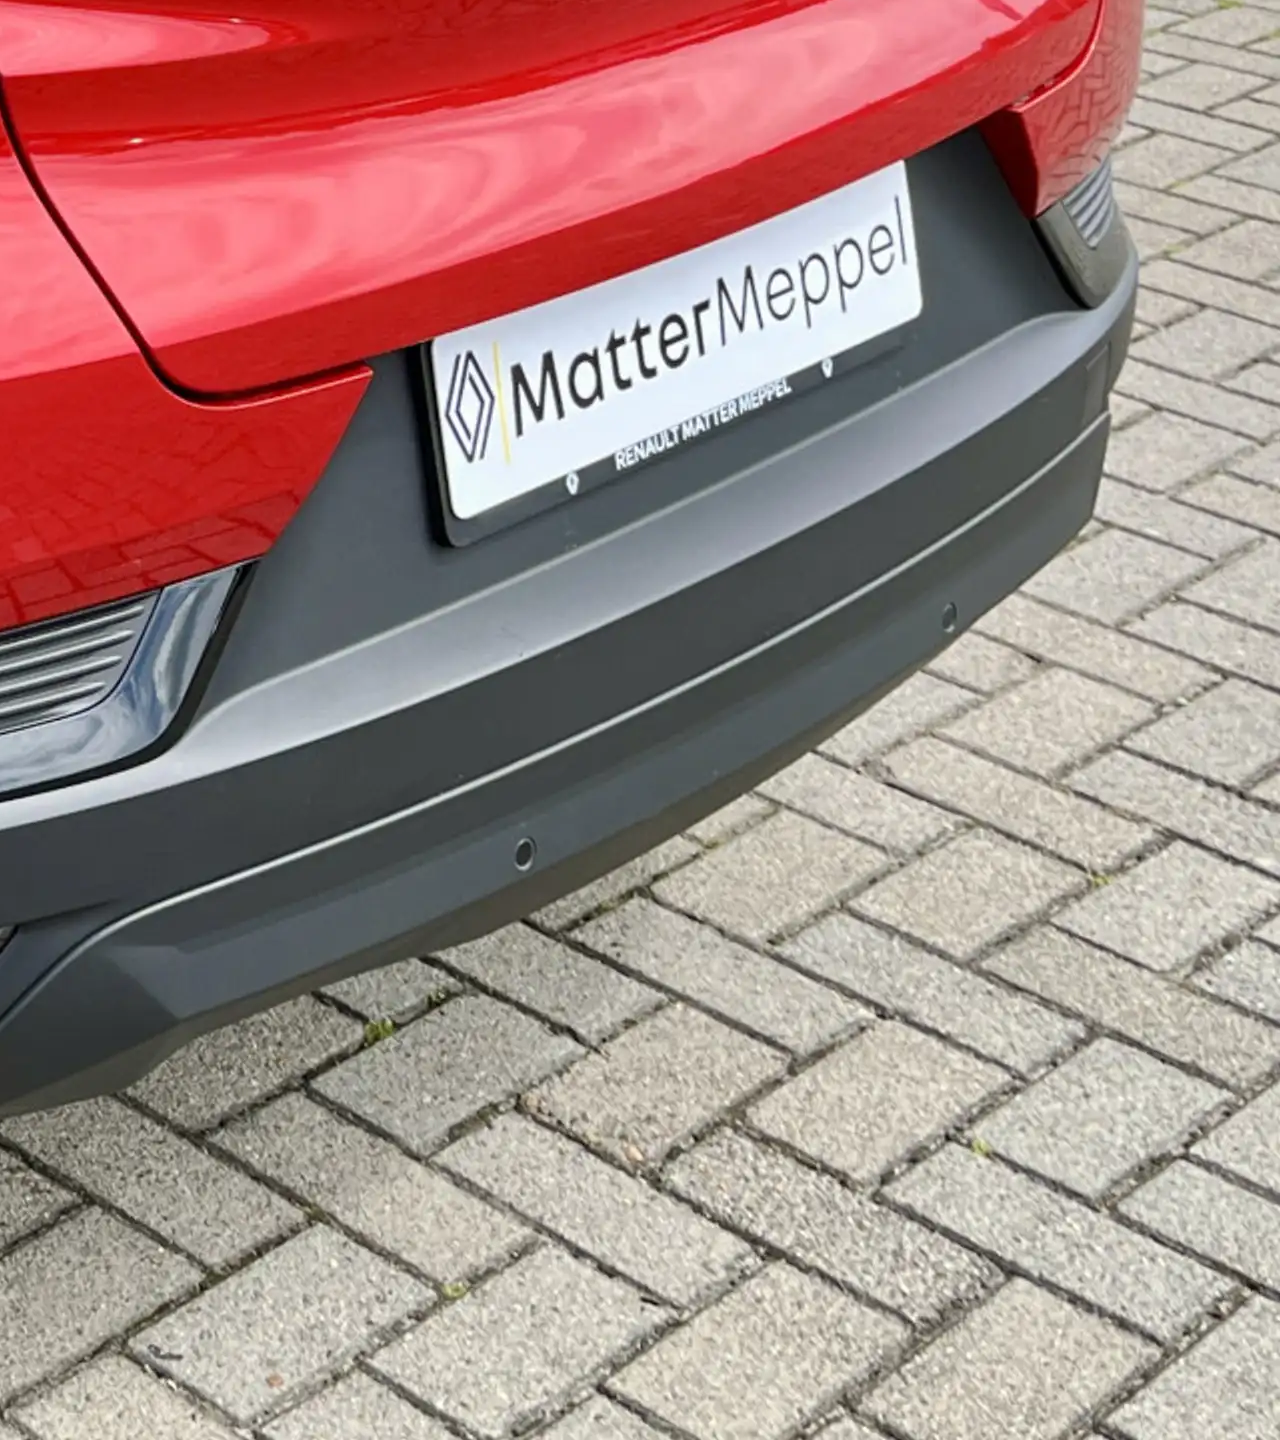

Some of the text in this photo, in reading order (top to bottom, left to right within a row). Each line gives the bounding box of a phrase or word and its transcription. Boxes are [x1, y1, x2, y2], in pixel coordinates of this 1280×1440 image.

[509, 195, 907, 438] MatterMeppel
[614, 376, 793, 471] RENAULT MATTER MEPPEL
